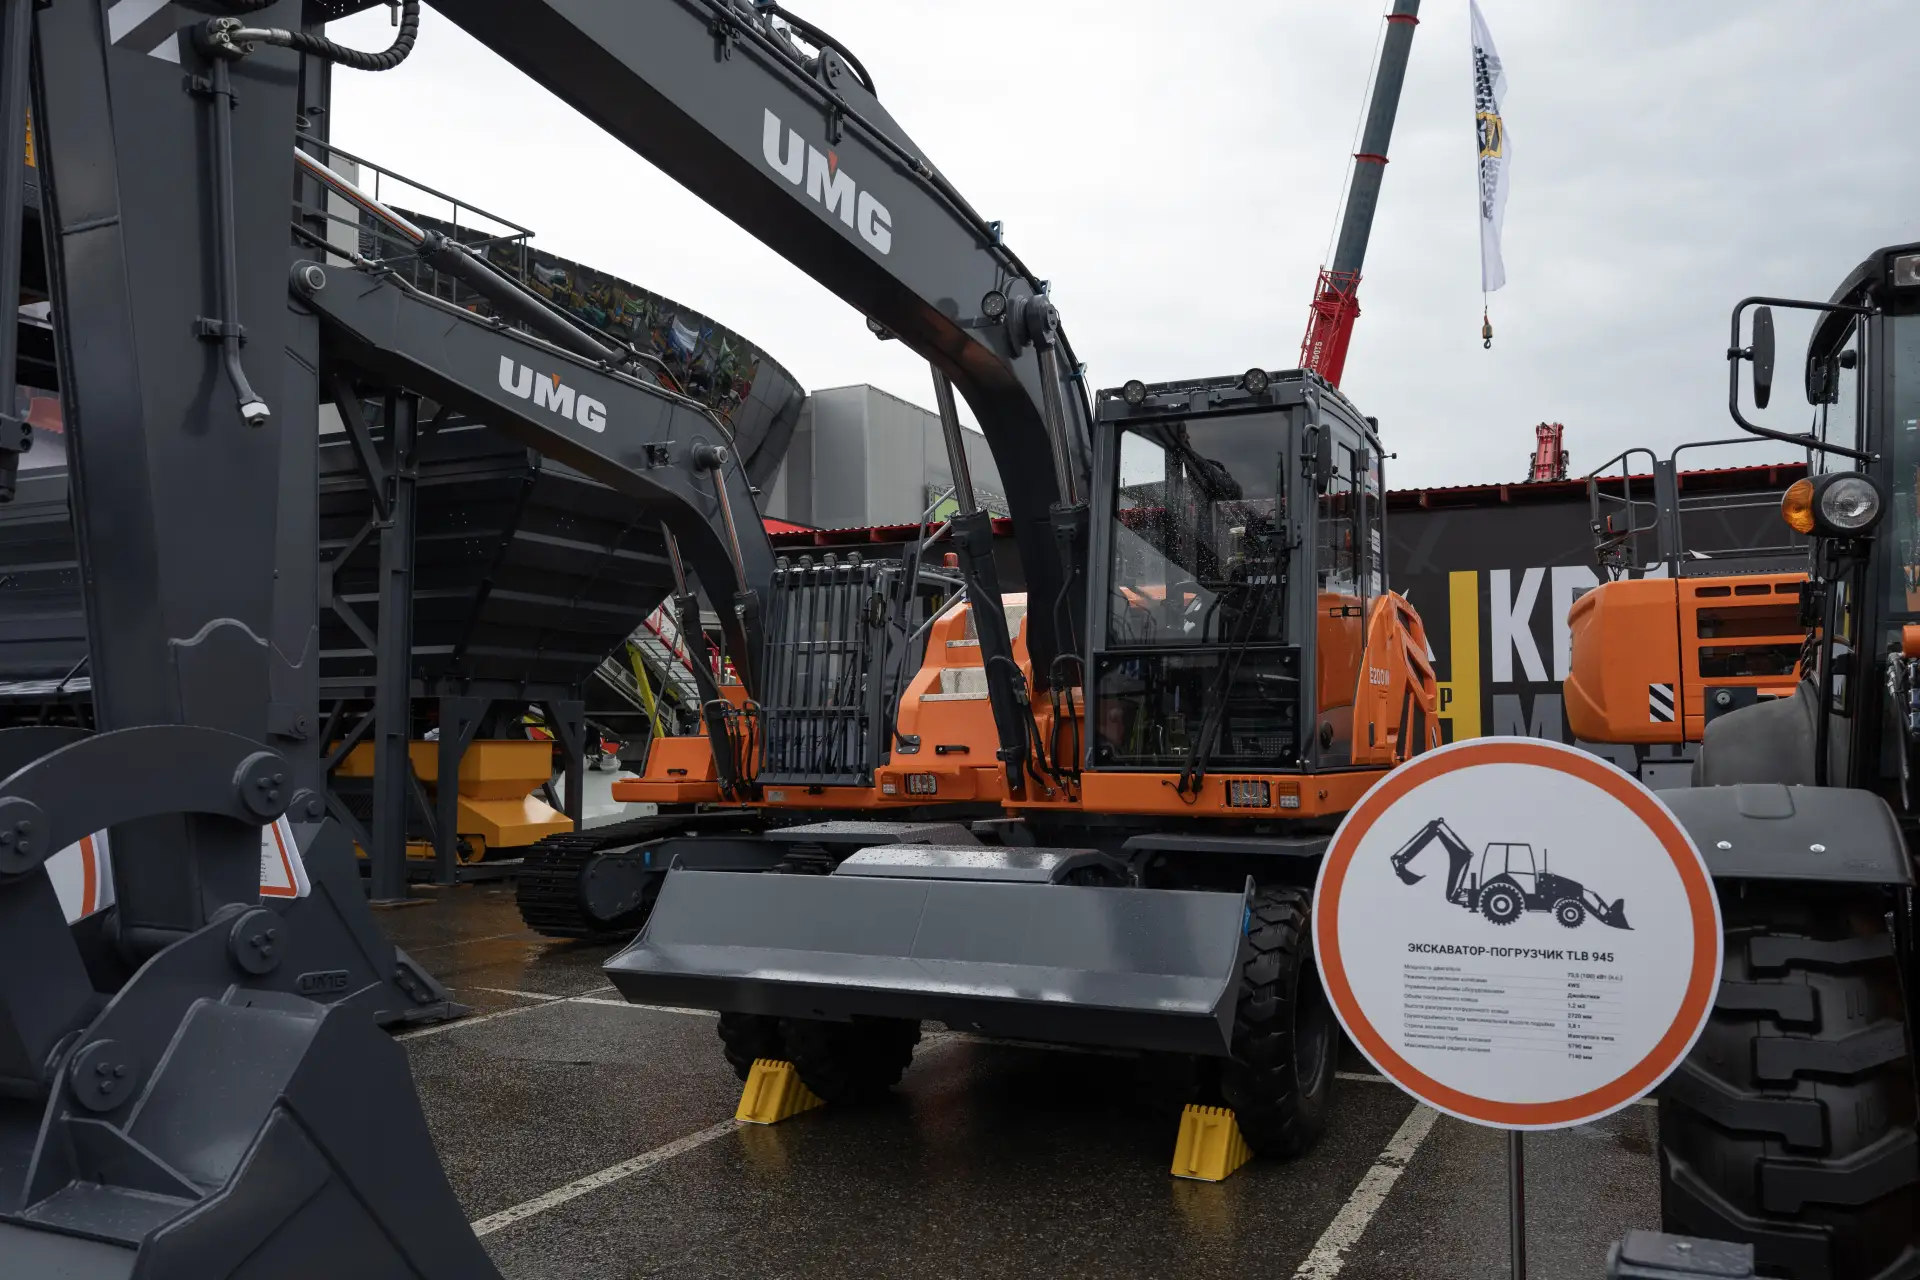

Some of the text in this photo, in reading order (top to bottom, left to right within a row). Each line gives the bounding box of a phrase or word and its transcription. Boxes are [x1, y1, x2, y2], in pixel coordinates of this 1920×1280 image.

[762, 107, 892, 255] UMG
[498, 355, 607, 433] UMG
[1408, 943, 1614, 963] ЭКСКАВАТОР-ПОГРУЗЧИК TLB 945
